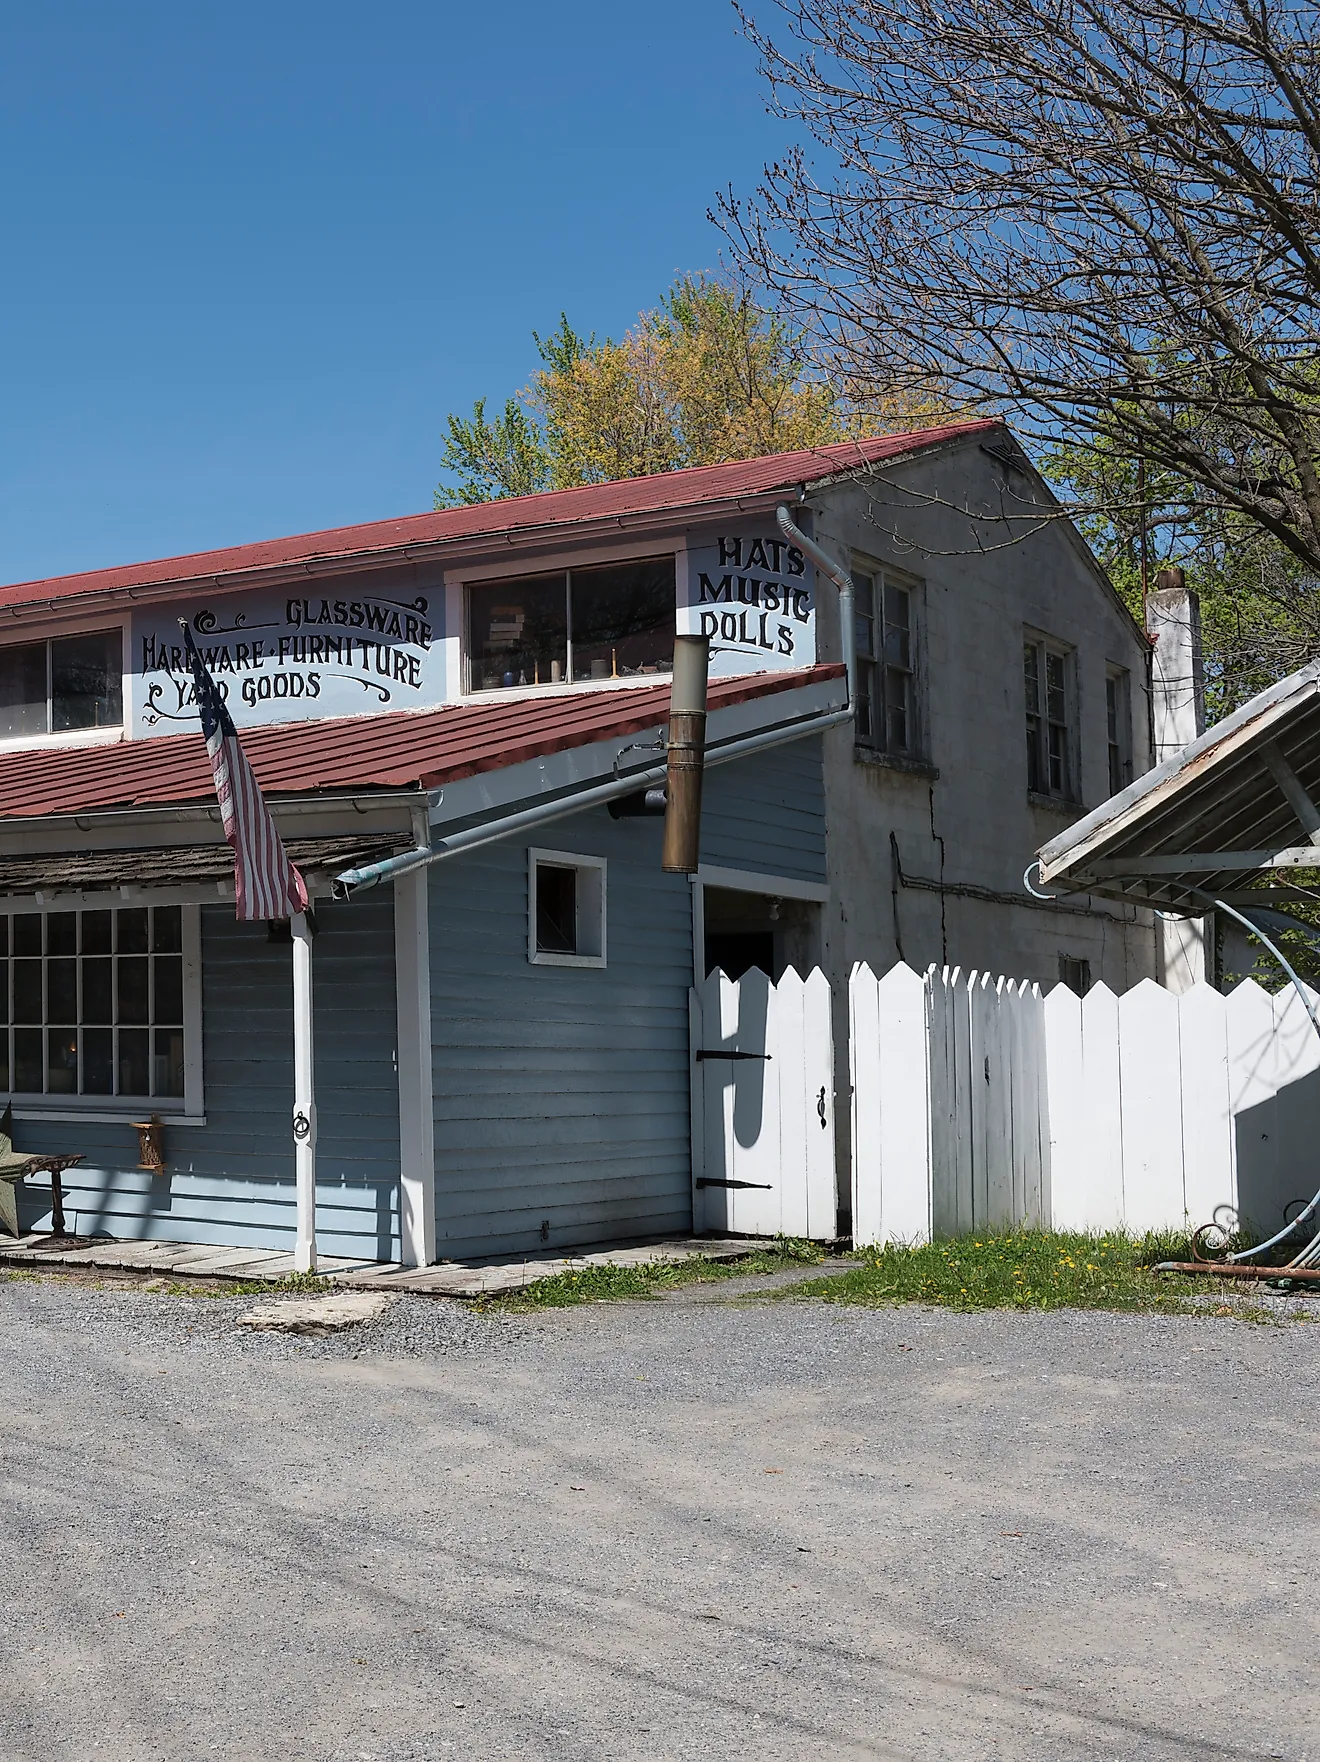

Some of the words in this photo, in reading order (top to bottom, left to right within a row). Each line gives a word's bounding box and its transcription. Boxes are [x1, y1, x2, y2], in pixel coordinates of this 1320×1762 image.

[717, 536, 805, 577] HATS
[698, 573, 810, 624] MUSIC
[285, 599, 432, 651] GLASSWARE
[700, 609, 794, 656] DOLLS
[277, 634, 423, 690] FURNITURE
[173, 680, 230, 713] YAD
[242, 670, 322, 708] GOODS
